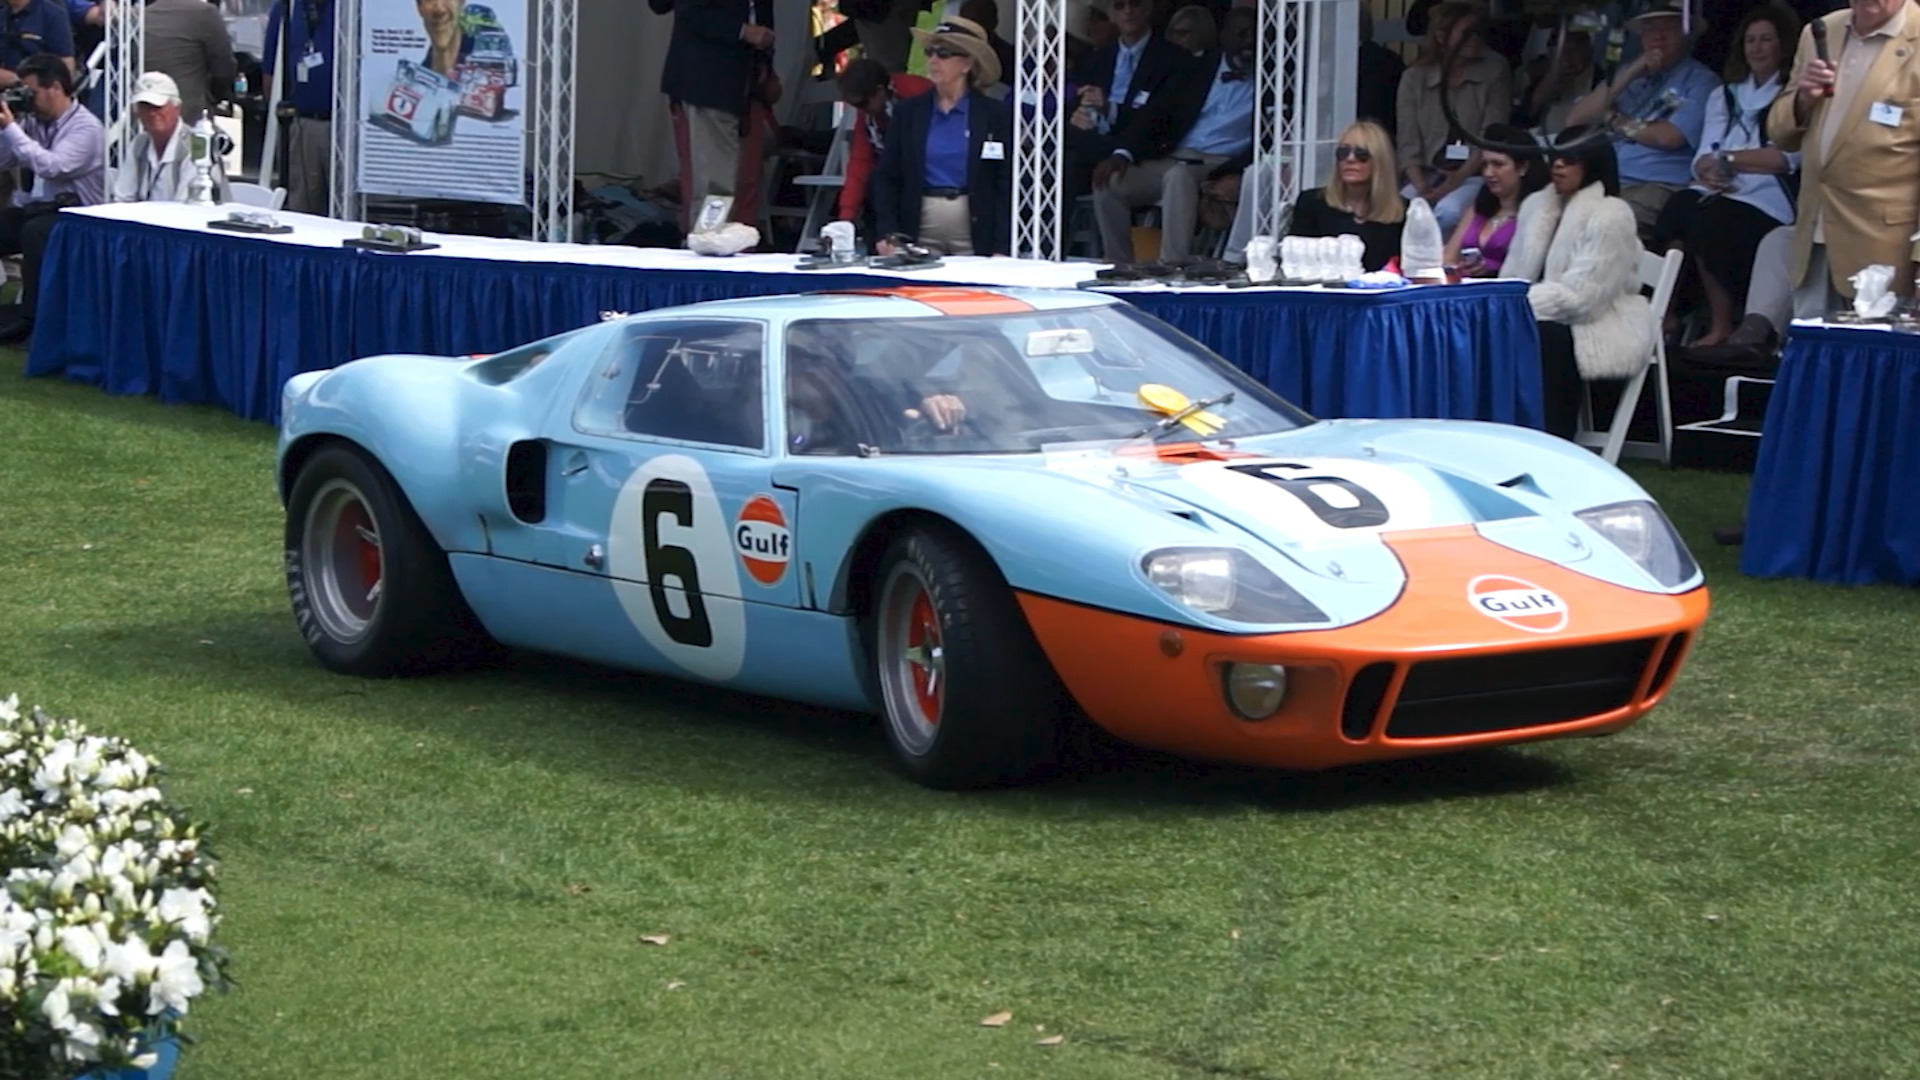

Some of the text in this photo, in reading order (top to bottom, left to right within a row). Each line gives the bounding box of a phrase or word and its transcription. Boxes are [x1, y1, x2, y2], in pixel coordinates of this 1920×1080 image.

[1223, 463, 1390, 529] 6
[642, 477, 713, 648] 6
[737, 525, 789, 557] Gulf
[1479, 594, 1556, 612] Gulf
